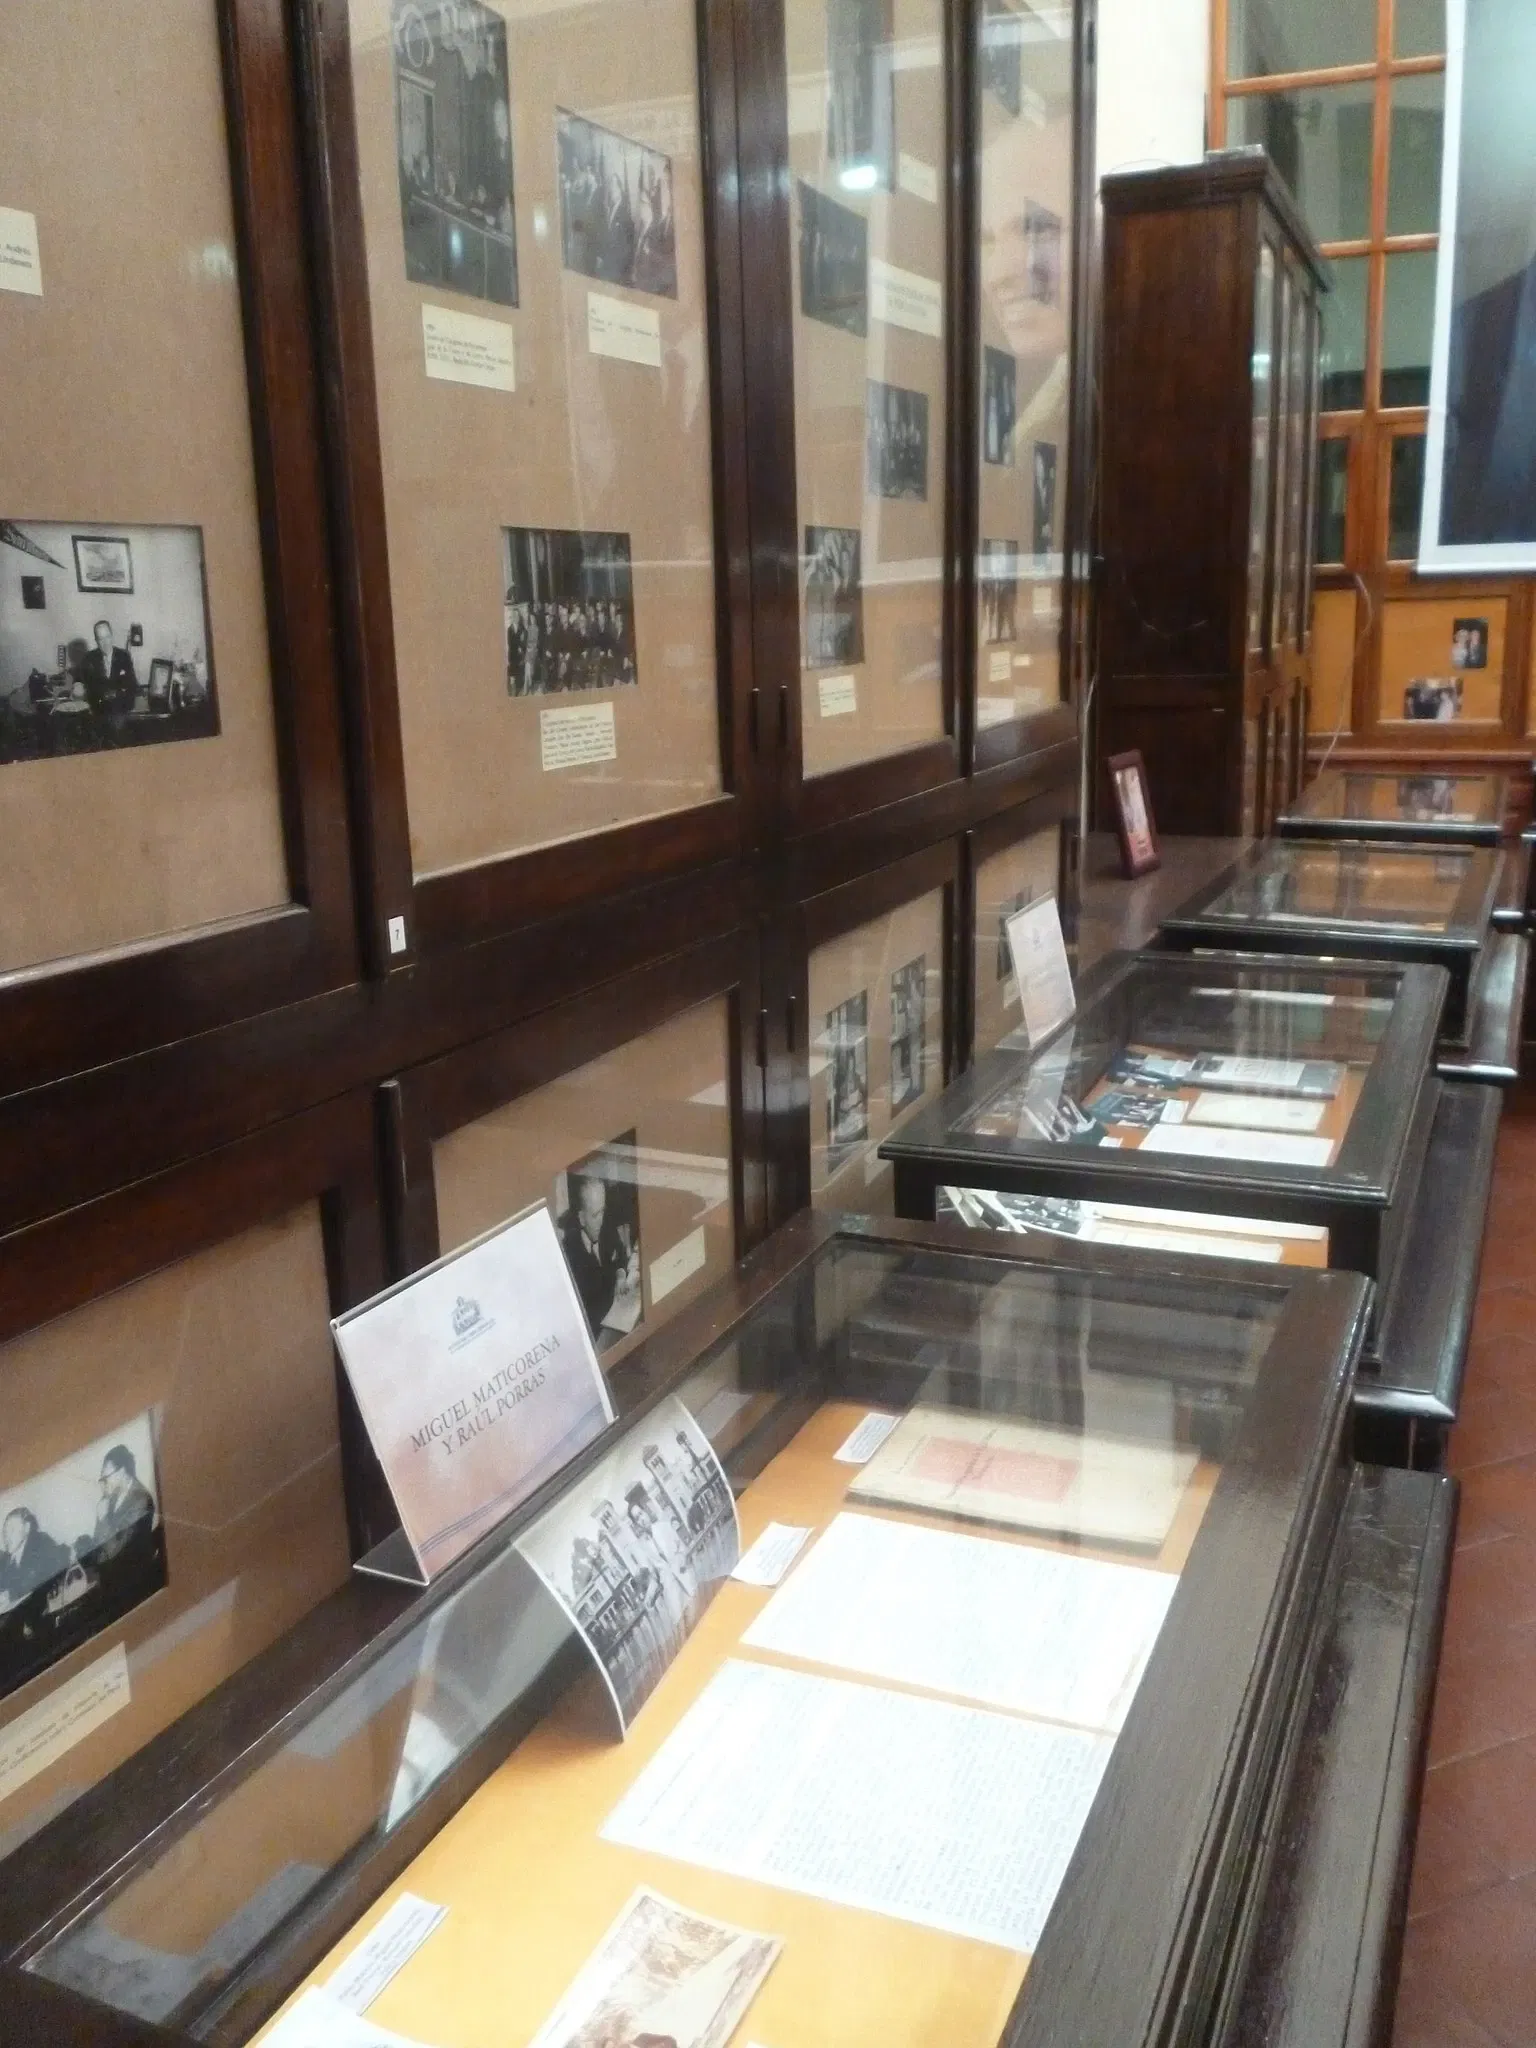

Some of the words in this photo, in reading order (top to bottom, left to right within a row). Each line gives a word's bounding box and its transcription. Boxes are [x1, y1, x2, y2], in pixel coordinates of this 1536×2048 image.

[410, 1398, 471, 1453] MIGUEL
[472, 1334, 561, 1407] MATICORENA
[442, 1434, 453, 1456] Y
[496, 1367, 547, 1416] PORRAS
